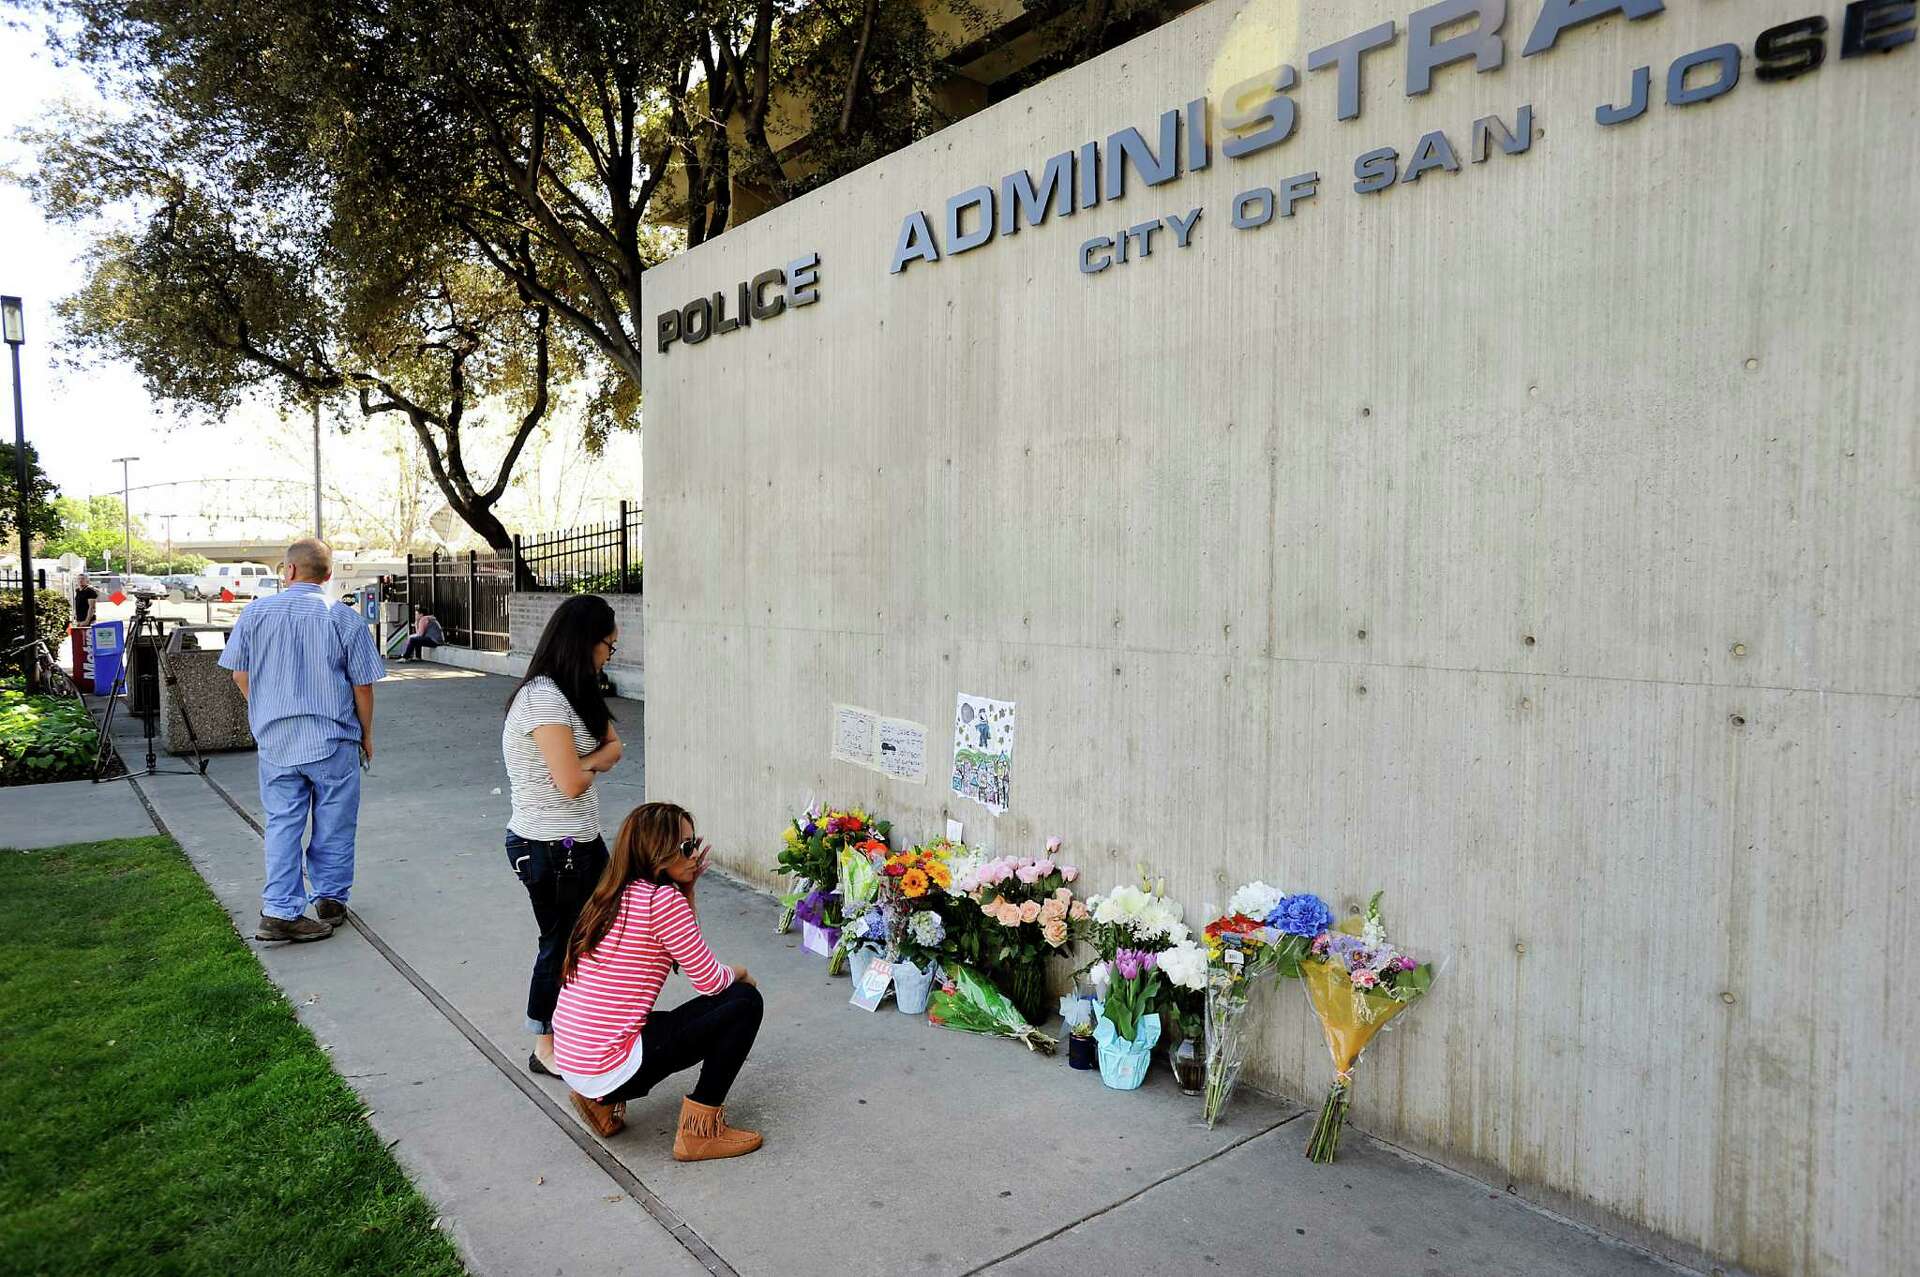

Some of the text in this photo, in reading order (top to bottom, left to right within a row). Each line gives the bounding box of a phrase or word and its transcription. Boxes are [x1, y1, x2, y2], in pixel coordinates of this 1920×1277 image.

[1079, 0, 1918, 274] CITY OF SAN JOSE
[657, 252, 821, 353] POLICE
